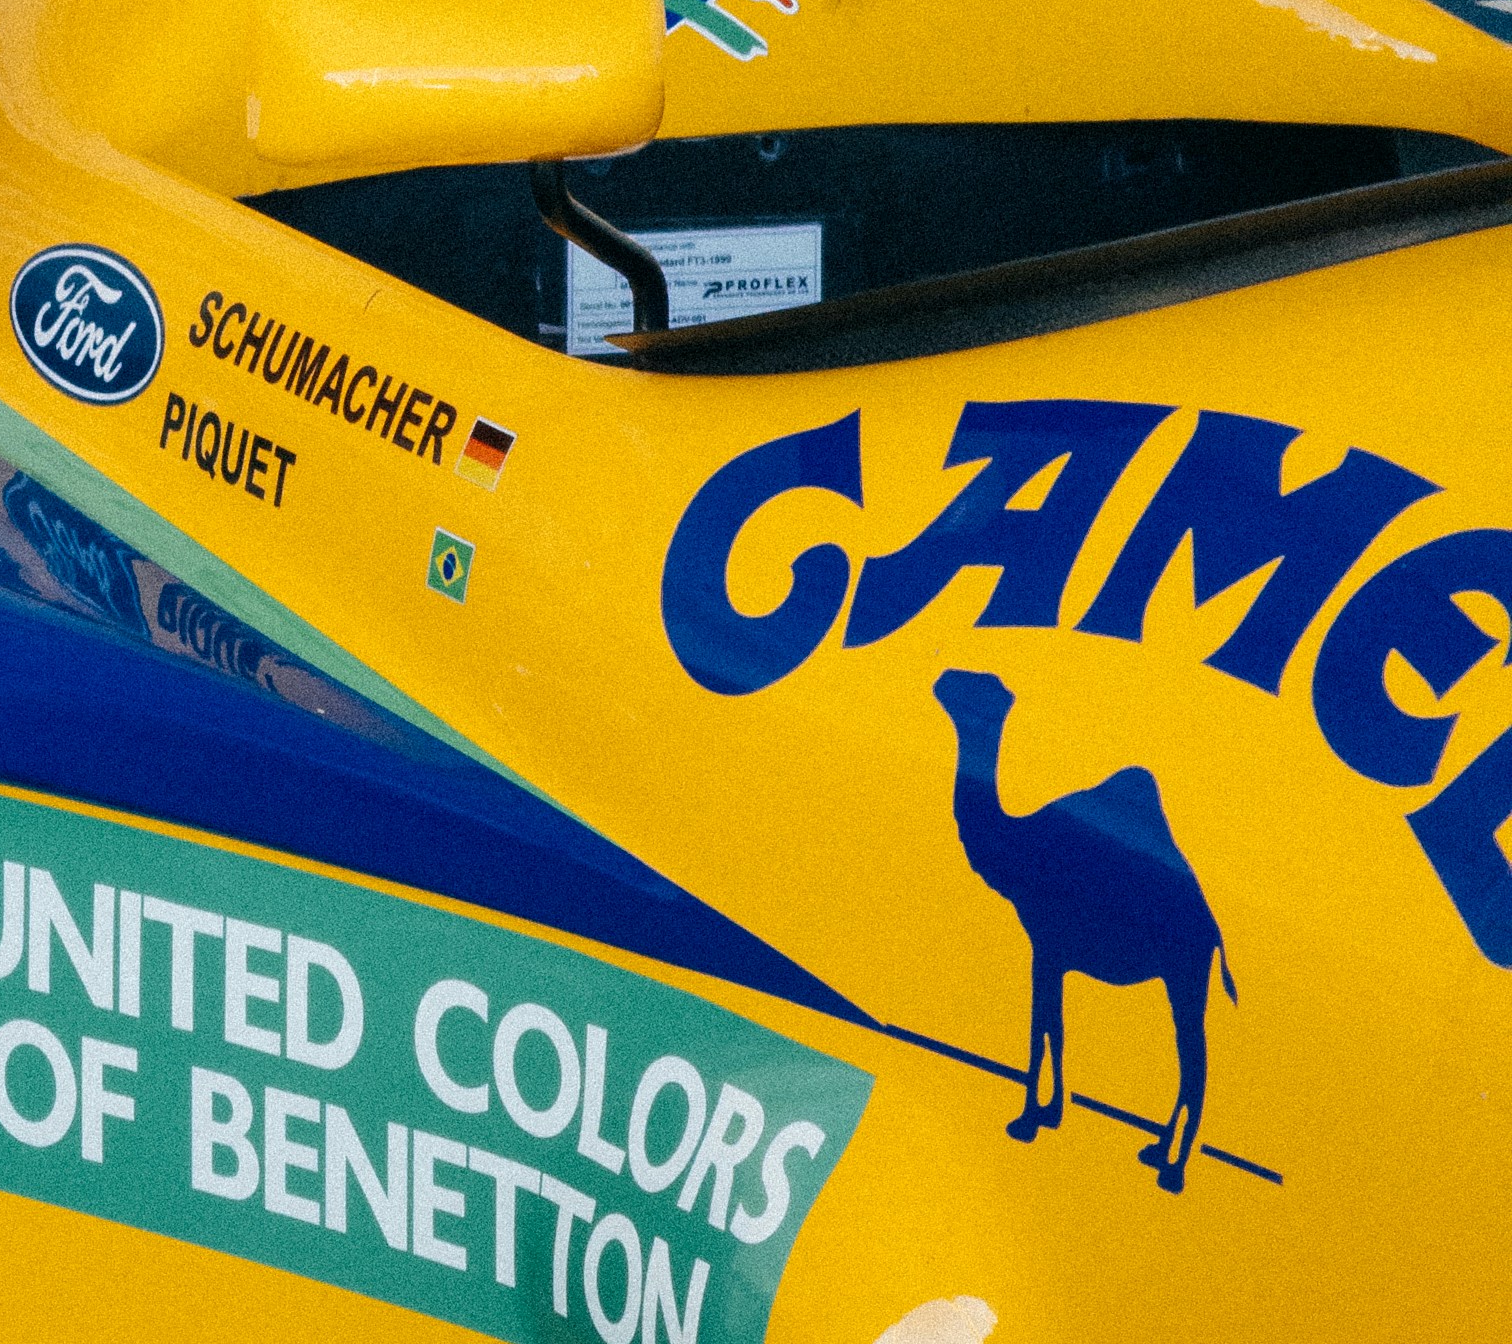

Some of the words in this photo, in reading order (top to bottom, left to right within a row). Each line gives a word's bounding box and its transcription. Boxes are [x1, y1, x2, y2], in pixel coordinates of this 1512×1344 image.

[33, 264, 137, 383] Ford
[725, 275, 809, 291] PROFLEX
[188, 290, 458, 466] SCHUMACHER
[159, 391, 297, 508] PIQUET
[414, 979, 826, 1244] COLORS
